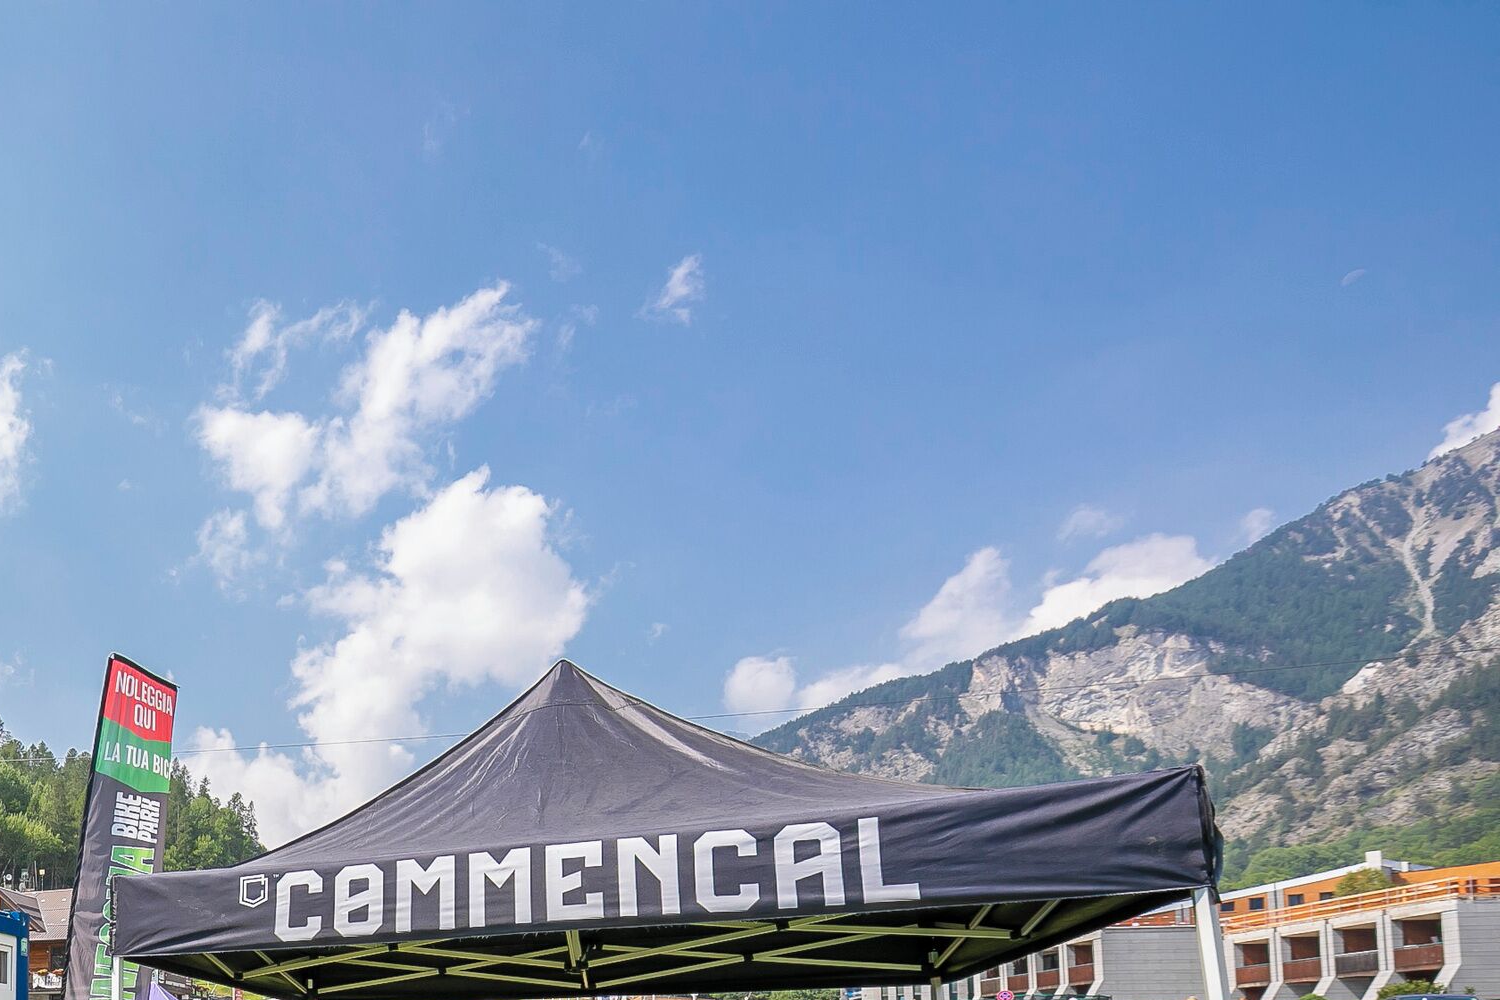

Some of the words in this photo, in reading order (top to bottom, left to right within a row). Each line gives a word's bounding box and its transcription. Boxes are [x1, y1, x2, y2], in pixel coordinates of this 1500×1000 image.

[115, 670, 172, 717] NOLEGGIA
[134, 704, 156, 732] QUI
[104, 741, 120, 763] LA
[126, 744, 149, 771] TUA
[111, 791, 142, 839] BIKE
[137, 797, 160, 845] PARK
